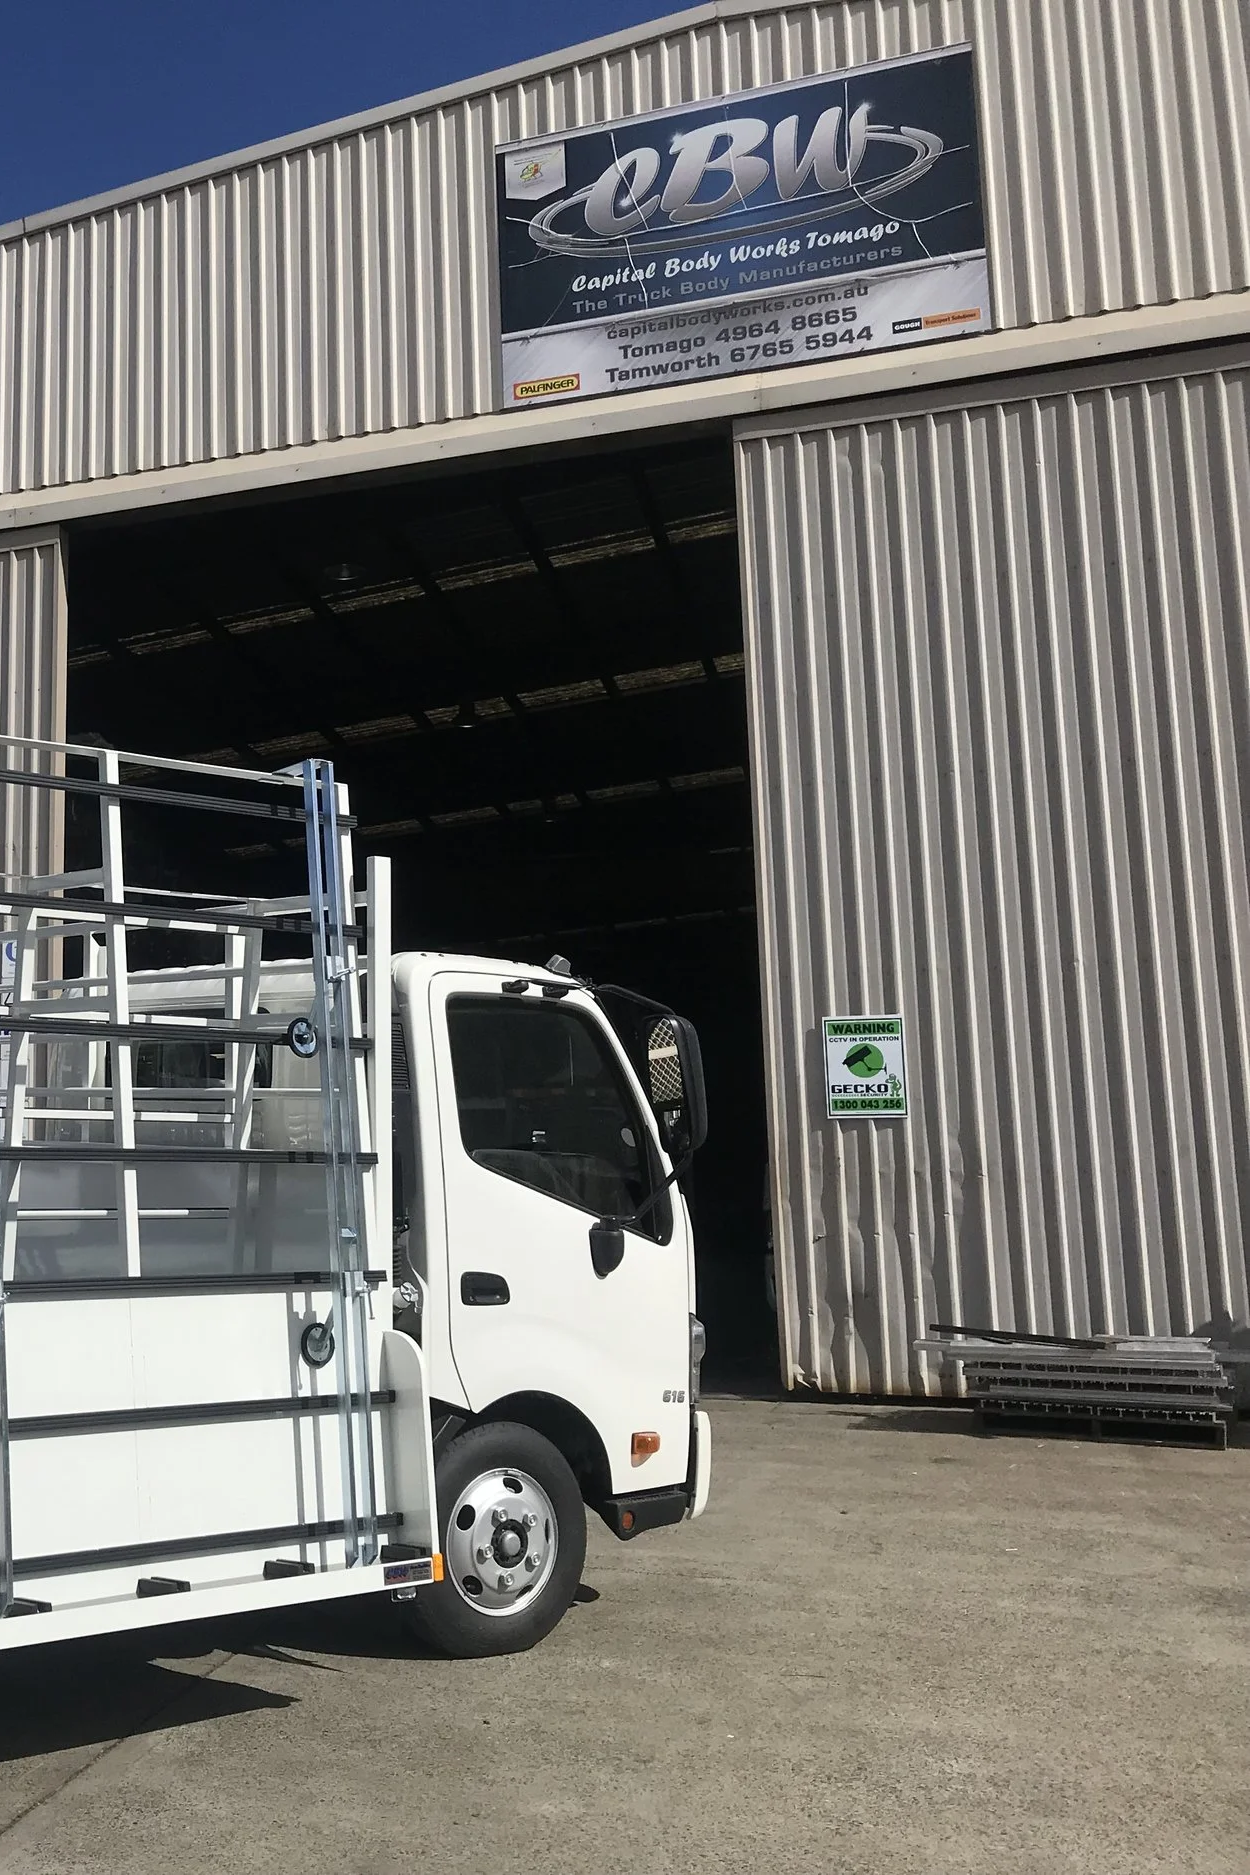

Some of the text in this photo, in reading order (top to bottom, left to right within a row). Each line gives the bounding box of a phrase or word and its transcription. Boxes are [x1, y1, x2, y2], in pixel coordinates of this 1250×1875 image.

[571, 220, 901, 293] Capital Body Works Tomago
[572, 244, 903, 315] The Truck Body Manufacturers
[606, 284, 869, 341] capitalbodyworks.com.au
[619, 306, 858, 360] Tomago 4964 8665
[894, 321, 921, 331] GOUGH
[605, 325, 873, 384] Tamworth 6765 5944
[520, 379, 575, 395] PALFINGER
[832, 1023, 895, 1034] WARNING
[831, 1084, 889, 1094] GECKO
[834, 1100, 902, 1109] 1300 043 256
[662, 1390, 685, 1403] 616
